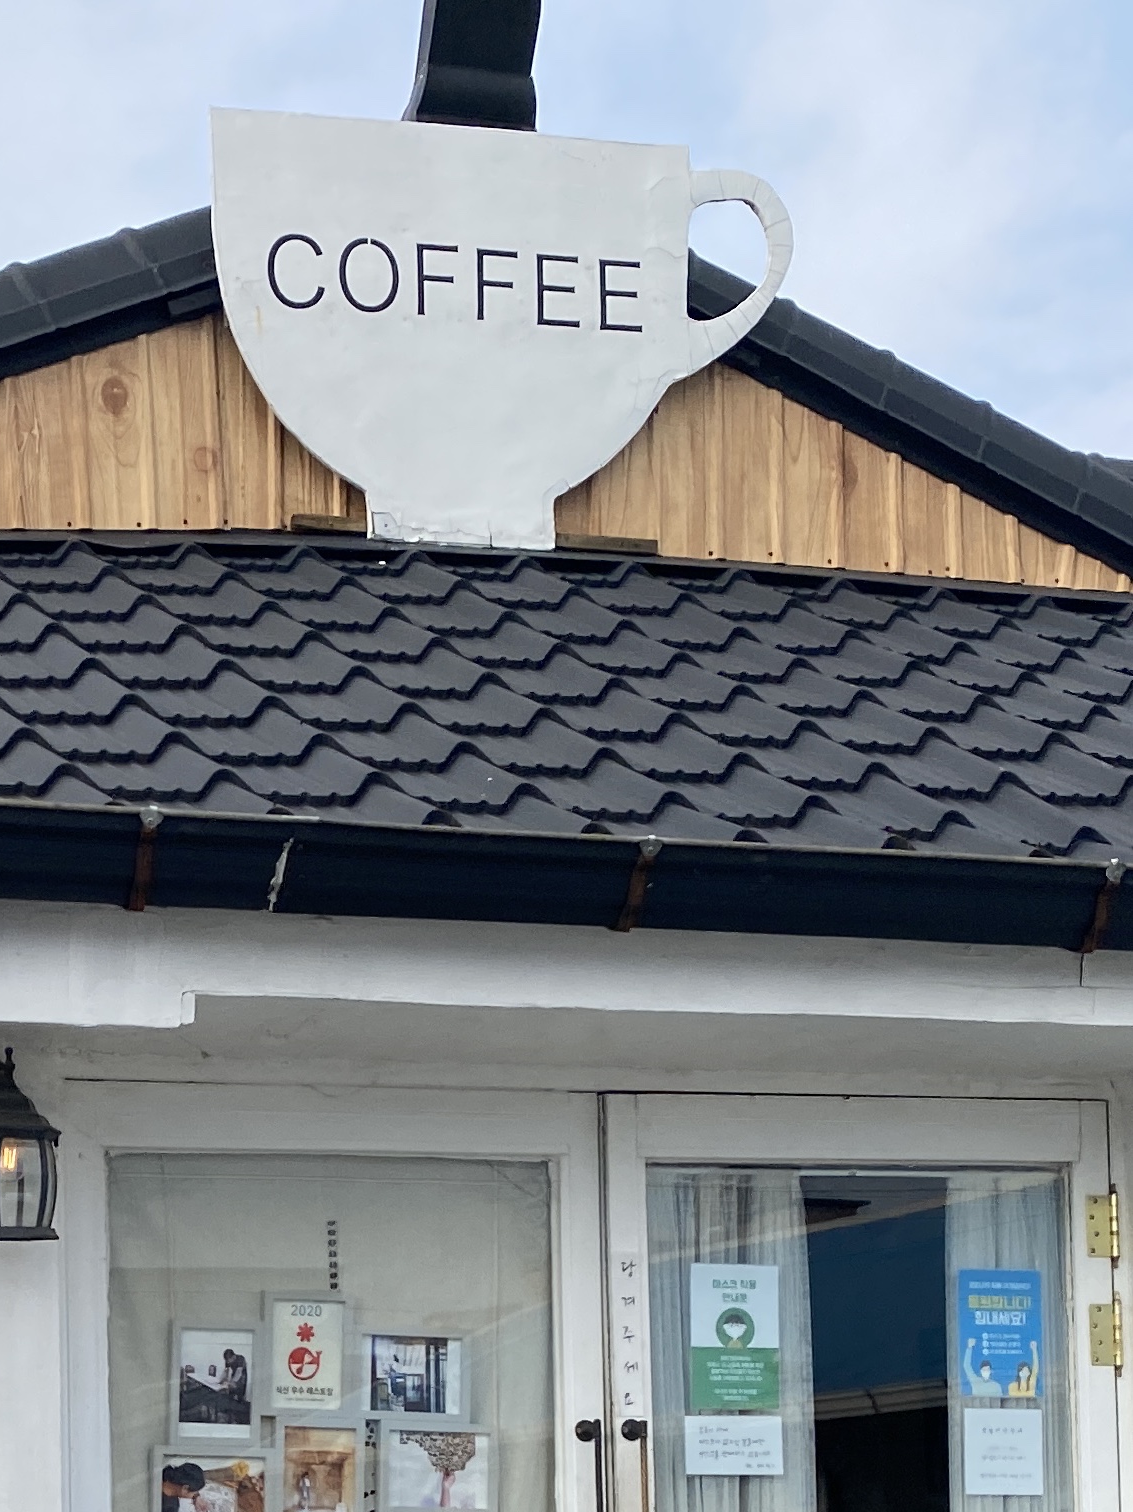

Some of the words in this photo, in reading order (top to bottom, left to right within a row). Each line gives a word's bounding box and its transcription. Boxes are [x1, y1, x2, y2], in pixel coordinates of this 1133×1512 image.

[267, 233, 643, 333] COFFEE
[712, 1279, 738, 1289] 마스크
[291, 1304, 323, 1317] 2020
[975, 1310, 1026, 1326] 힘내세요!
